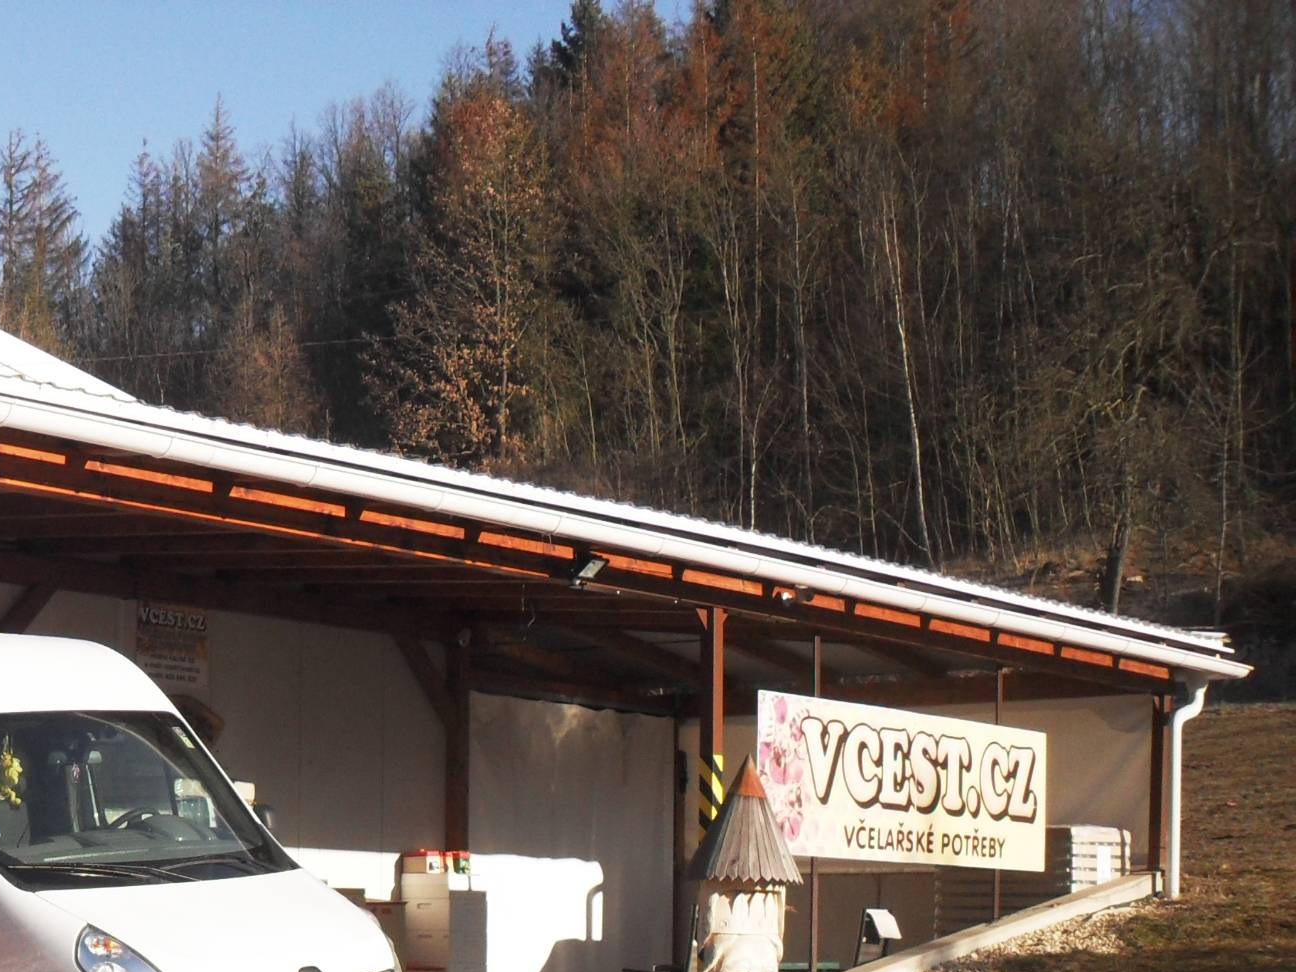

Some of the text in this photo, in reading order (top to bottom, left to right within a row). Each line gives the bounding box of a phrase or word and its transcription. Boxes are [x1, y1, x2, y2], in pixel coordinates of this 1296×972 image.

[139, 607, 207, 632] VCEST.CZ
[800, 716, 1037, 824] VCEST.CZ
[843, 818, 1006, 859] VČELAŘSKÉ POTŘEBY
